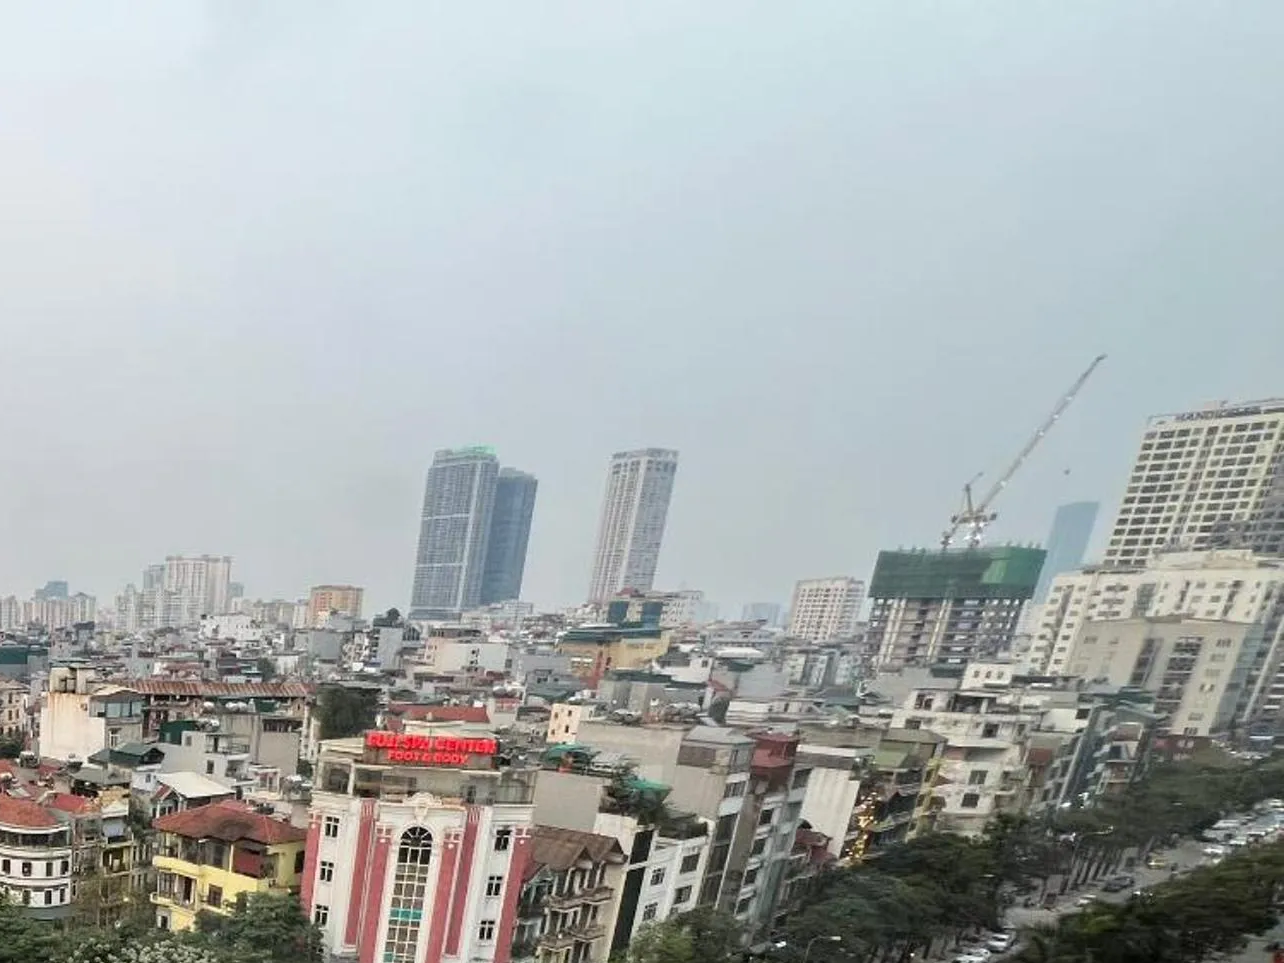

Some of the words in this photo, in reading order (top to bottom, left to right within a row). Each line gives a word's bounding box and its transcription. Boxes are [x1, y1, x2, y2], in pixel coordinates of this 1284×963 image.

[435, 736, 496, 754] CENTER
[388, 750, 420, 761] FOOT
[434, 752, 469, 764] BODY
